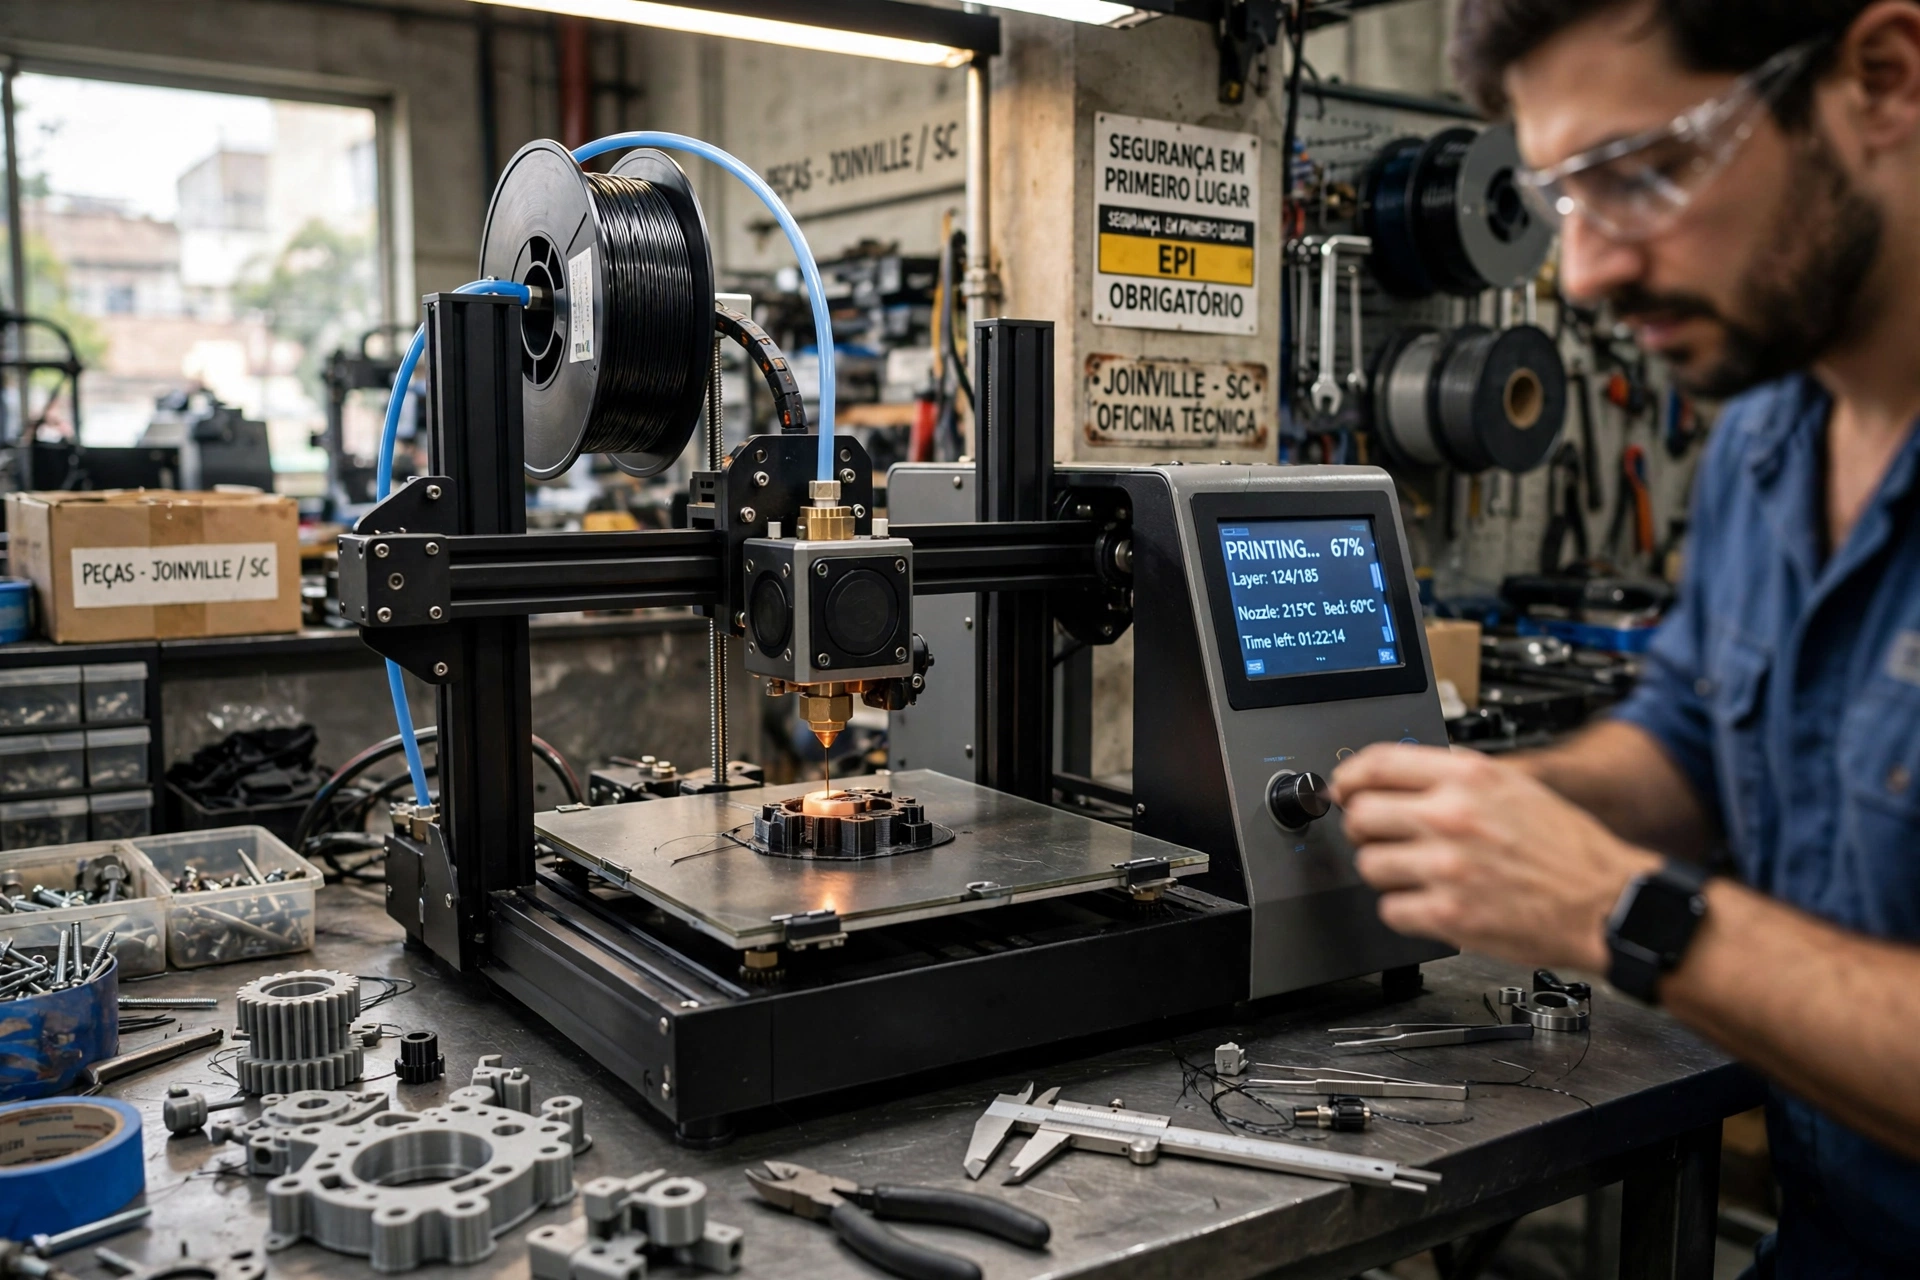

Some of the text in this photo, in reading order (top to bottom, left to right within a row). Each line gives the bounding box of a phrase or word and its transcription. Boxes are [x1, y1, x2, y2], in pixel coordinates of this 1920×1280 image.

[933, 121, 959, 162] SC
[1109, 133, 1245, 177] SEGURANÇA EM
[1104, 167, 1250, 209] PRIMEIRO LUGAR
[1158, 244, 1195, 277] EPI
[1109, 282, 1243, 319] OBRIGATÓRIO
[1103, 367, 1206, 399] JOINVILLE
[1226, 374, 1250, 400] SC
[1097, 402, 1257, 434] OFICINA TÉCNICA
[1226, 537, 1365, 561] PRINTING... 67%
[82, 561, 135, 590] PEÇAS
[151, 559, 232, 582] JOINVILLE
[236, 555, 246, 582] /
[250, 557, 270, 578] SC
[1231, 568, 1319, 589] Layer: 124/185
[1238, 598, 1376, 621] Nozzle: 215°C Bed: 60°C
[1242, 628, 1346, 650] Time left: 01:22:14
